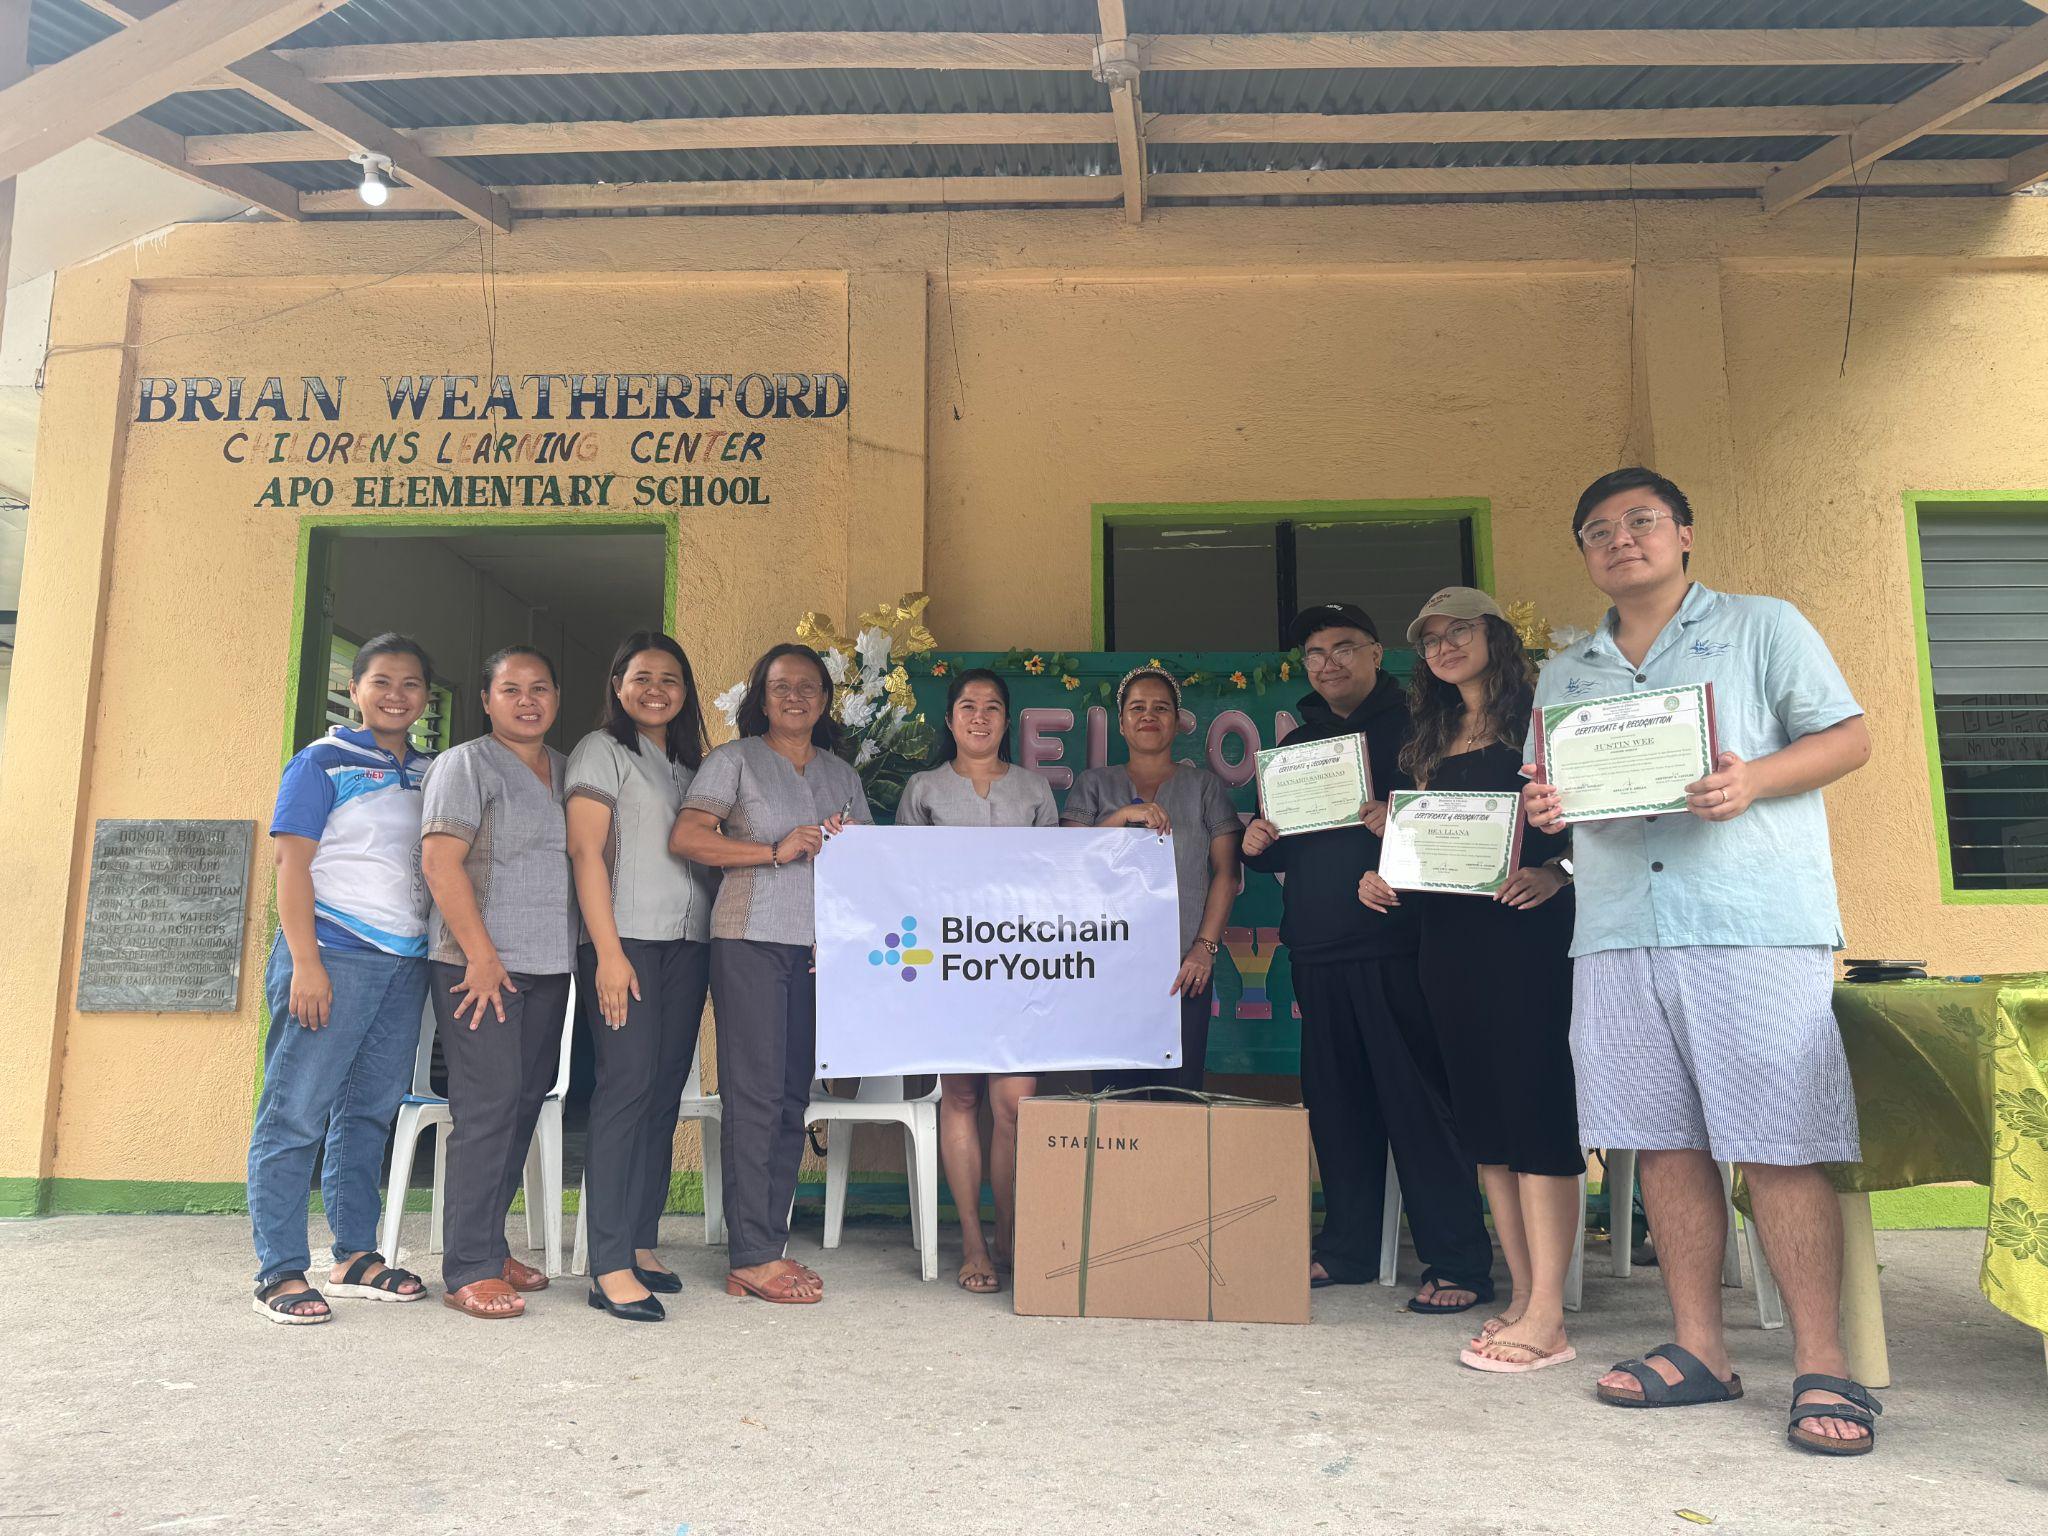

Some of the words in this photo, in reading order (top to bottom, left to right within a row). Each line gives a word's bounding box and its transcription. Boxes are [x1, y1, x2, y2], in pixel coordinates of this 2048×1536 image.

[133, 376, 347, 422] BRIAN
[379, 375, 849, 420] WEATHERFORD
[436, 431, 599, 464] LEARNING
[630, 430, 766, 464] CENTER
[254, 475, 334, 508] APO
[351, 475, 617, 507] ELEMENTARY
[633, 475, 771, 507] SCHOOL
[1574, 723, 1618, 736] CERTIFICATE
[1618, 723, 1626, 732] of
[1626, 715, 1673, 729] RECOGNITION
[1594, 741, 1631, 751] JUSTIN
[1632, 737, 1655, 747] WEE
[1414, 812, 1448, 820] CERTIFICATE
[1453, 813, 1490, 822] RECOGNITION
[176, 830, 226, 843] BOARD
[180, 911, 220, 921] WATERS
[942, 914, 1129, 944] Blockchain
[942, 951, 1096, 981] ForYouth
